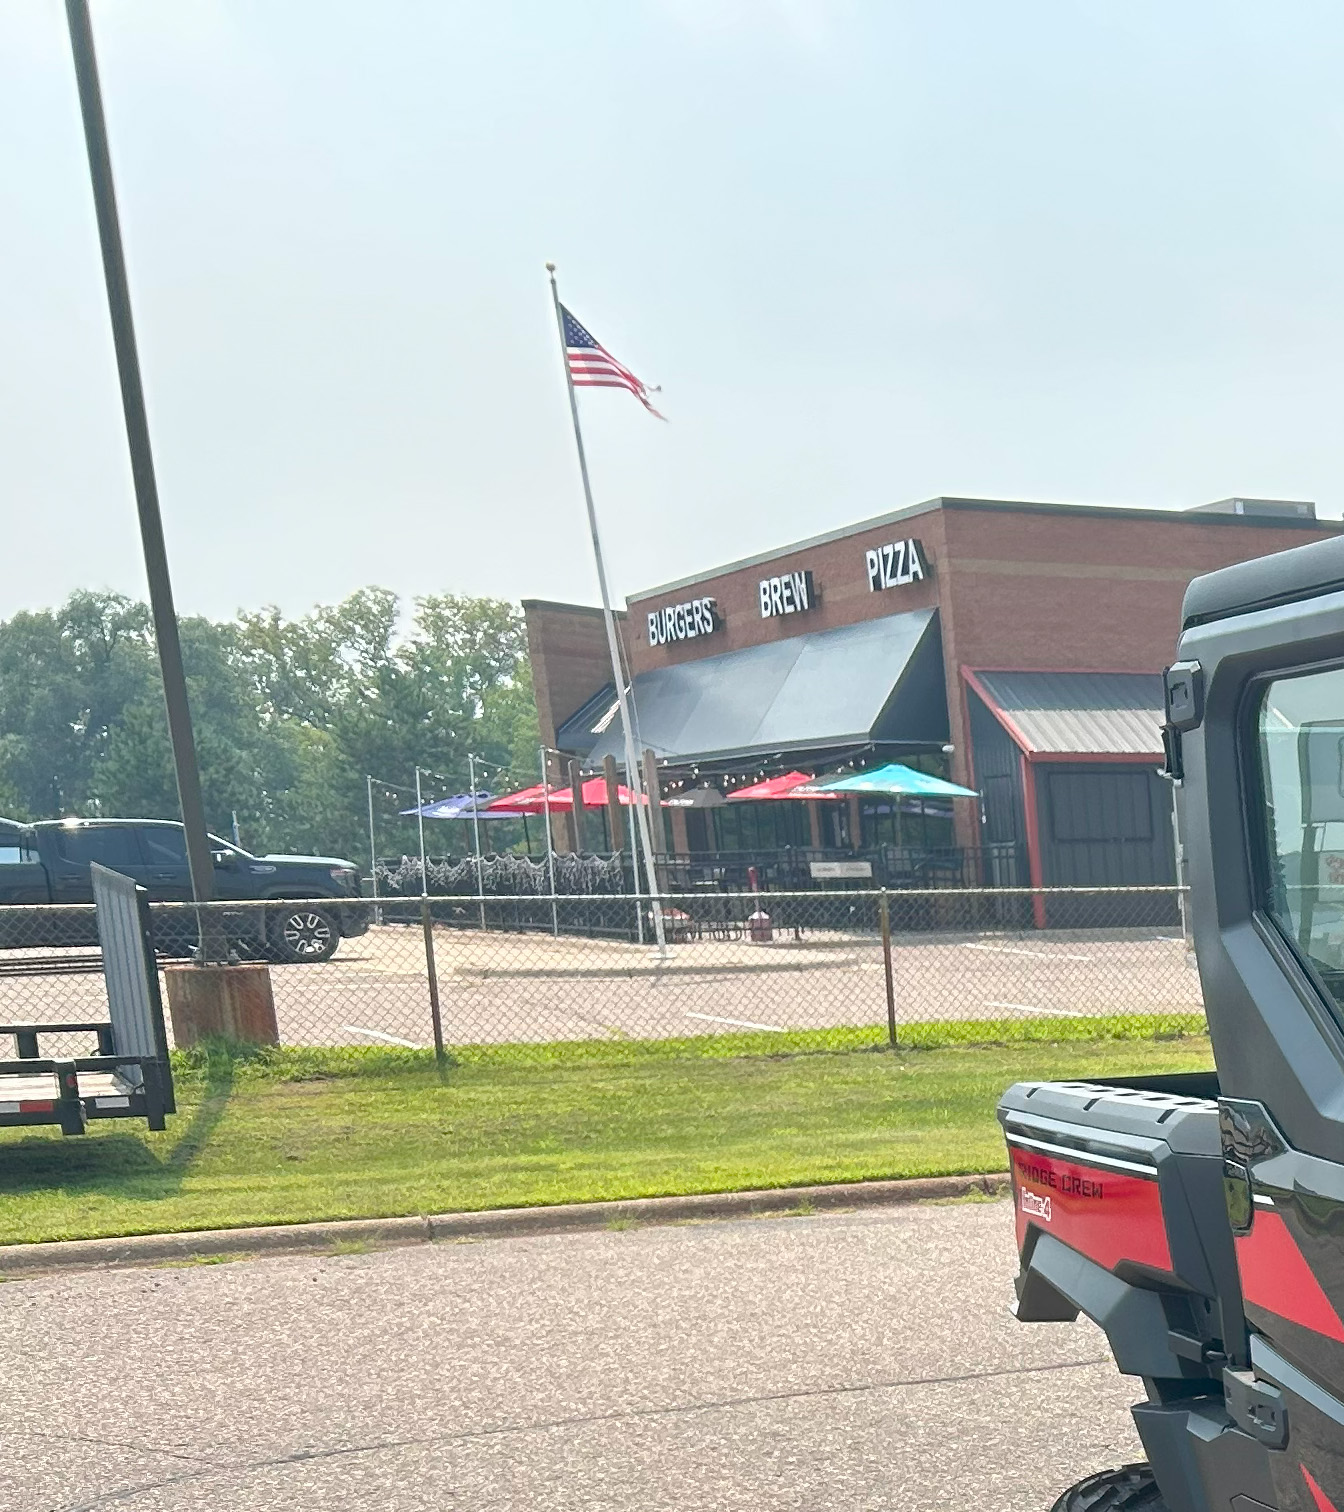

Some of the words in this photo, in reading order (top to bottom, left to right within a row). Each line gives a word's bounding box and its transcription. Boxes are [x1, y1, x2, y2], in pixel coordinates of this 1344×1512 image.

[648, 598, 715, 647] BURGERS
[759, 571, 809, 618] BREW
[865, 538, 924, 592] PIZZA
[1061, 1174, 1103, 1200] CREW
